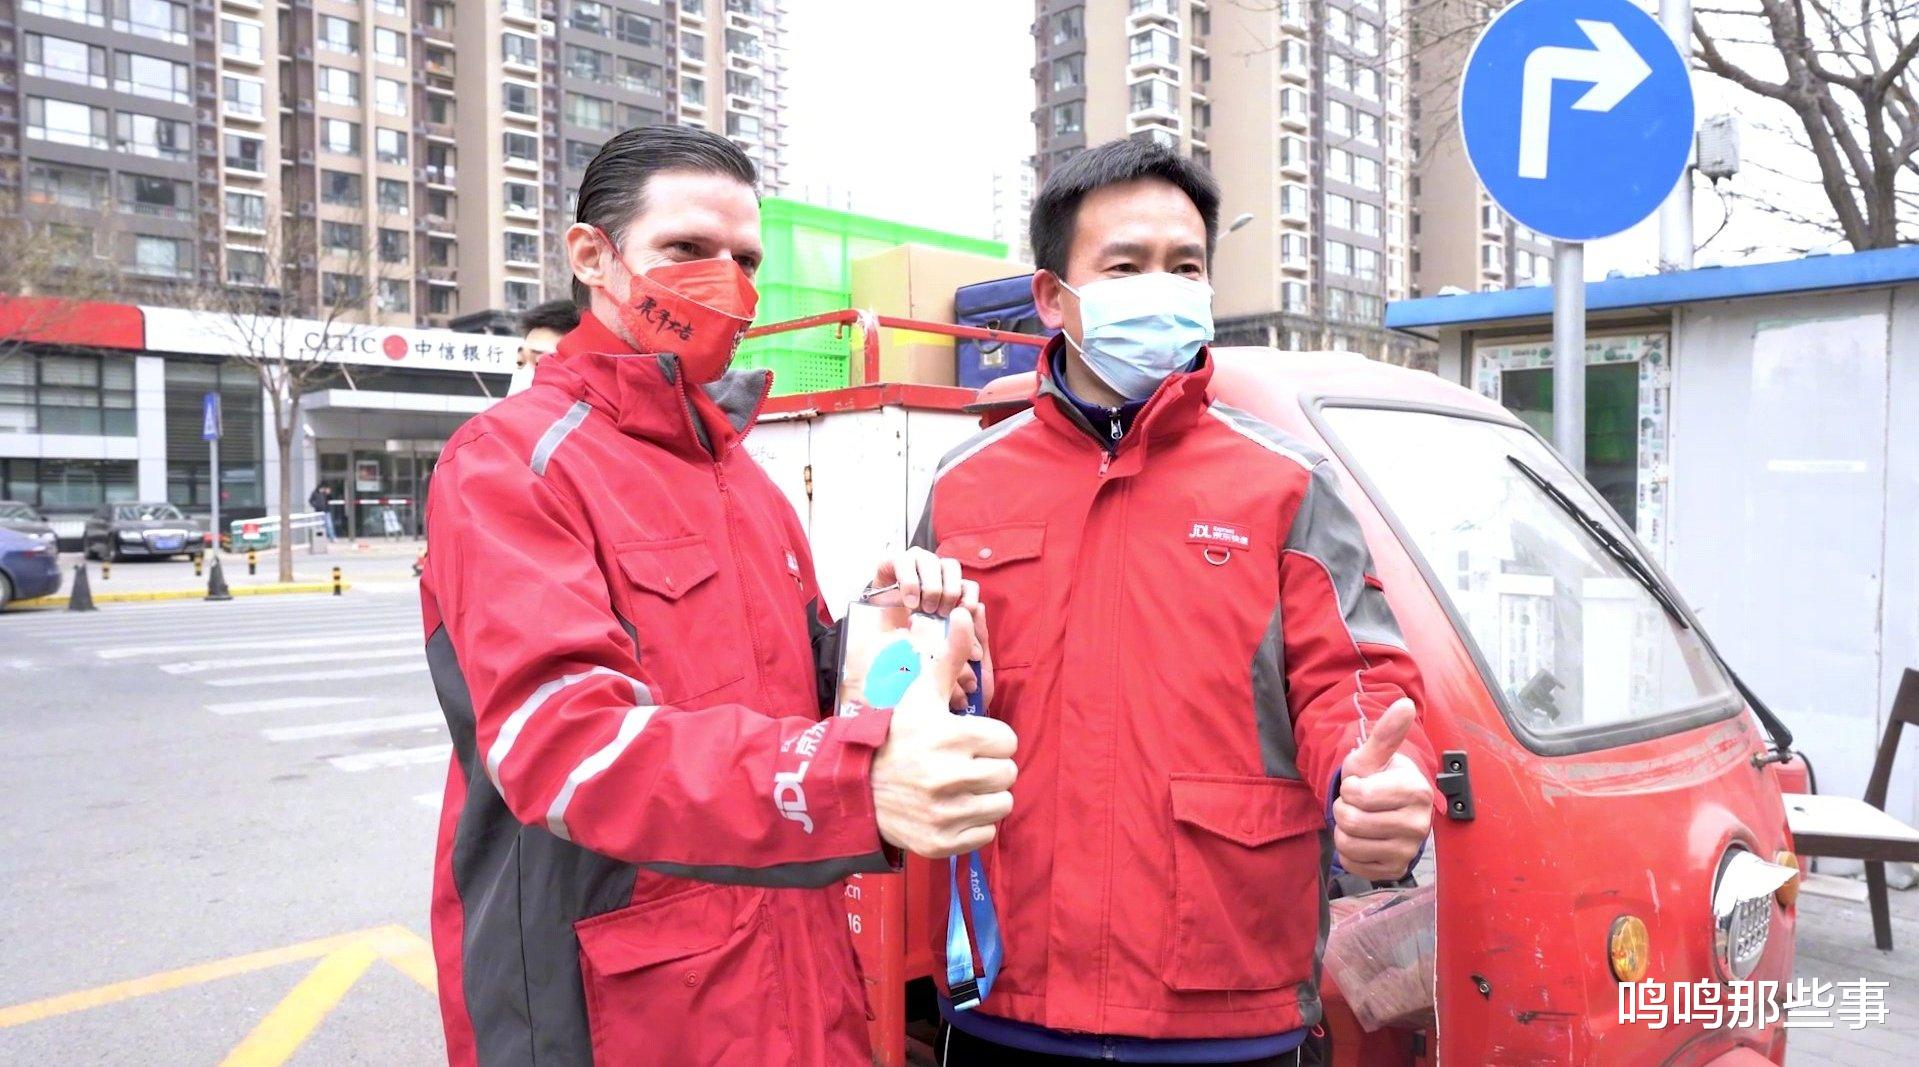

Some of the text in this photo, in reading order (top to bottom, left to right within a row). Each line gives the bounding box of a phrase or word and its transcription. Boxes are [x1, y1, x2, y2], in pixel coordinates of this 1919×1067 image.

[635, 295, 694, 341] 虎年大吉
[305, 331, 504, 363] CITIC 中信银行
[1189, 523, 1212, 539] JDL
[773, 761, 814, 835] JDL
